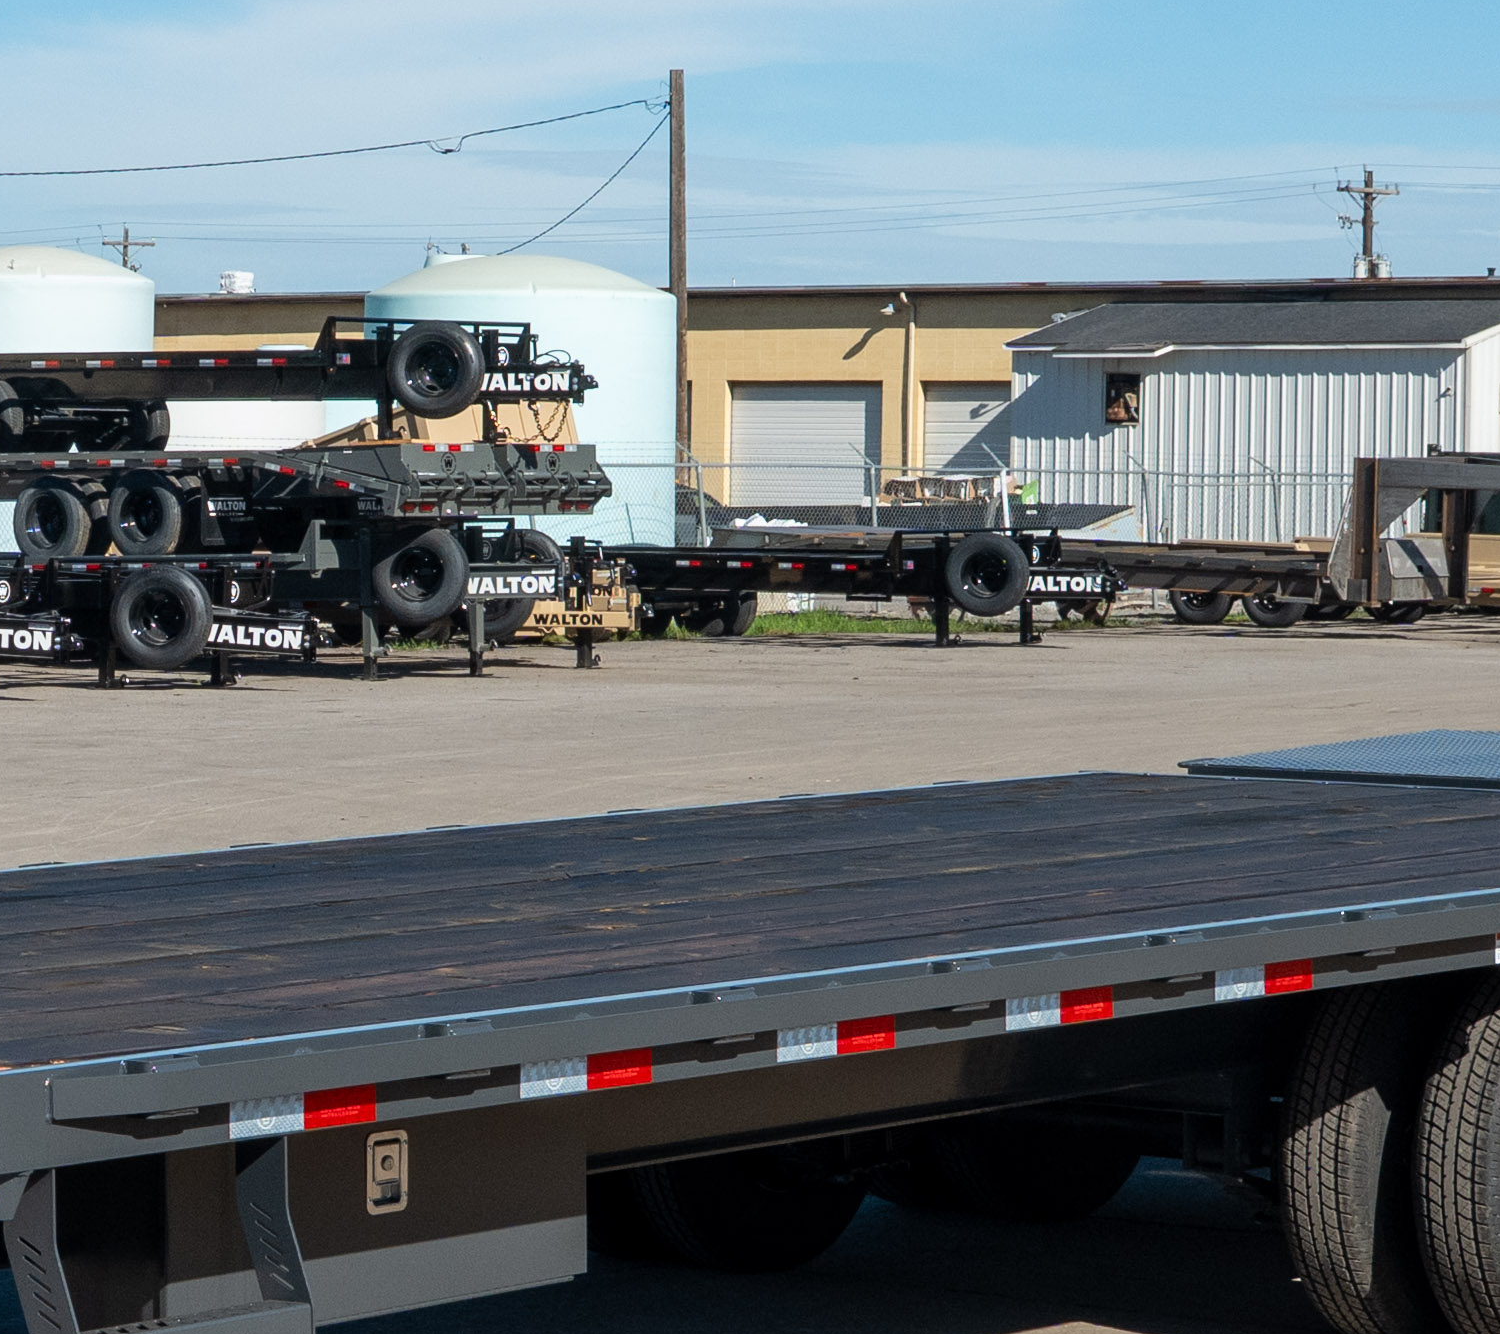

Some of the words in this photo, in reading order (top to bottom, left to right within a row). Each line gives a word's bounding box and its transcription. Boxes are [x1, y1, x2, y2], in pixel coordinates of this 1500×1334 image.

[480, 370, 570, 391] ALTON
[207, 500, 246, 512] WALTON
[1026, 575, 1102, 592] ALTON
[533, 613, 603, 626] WALTON
[207, 623, 303, 650] ALTON
